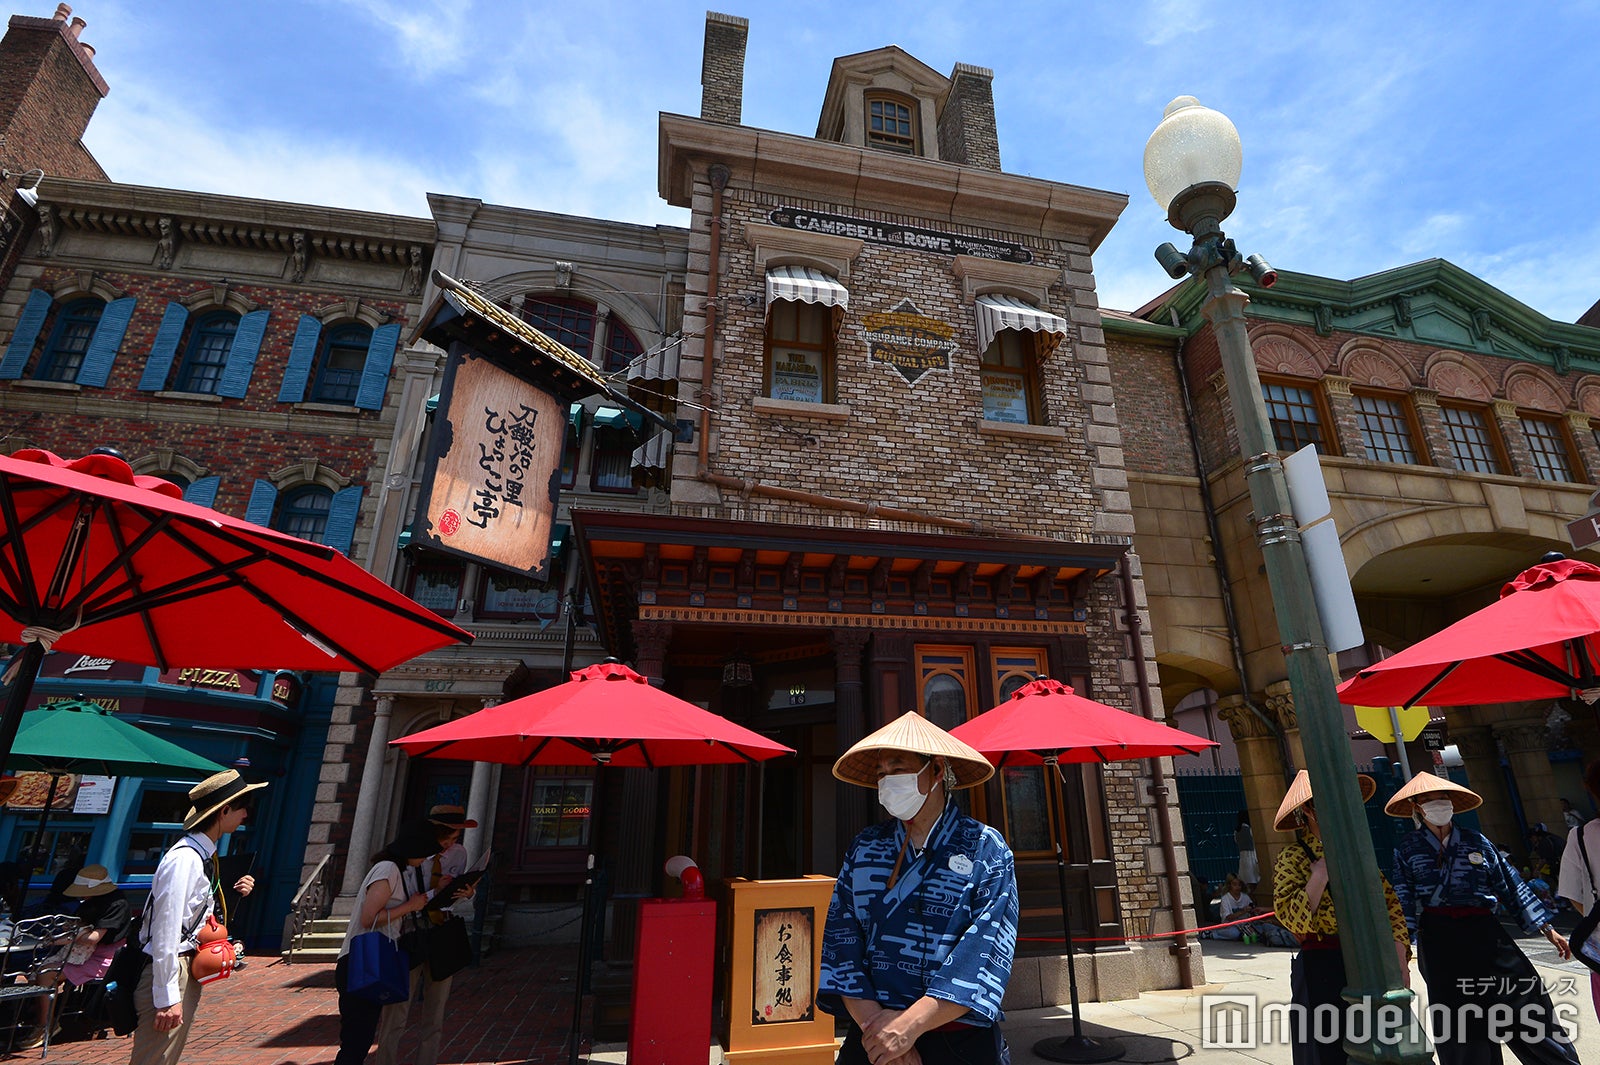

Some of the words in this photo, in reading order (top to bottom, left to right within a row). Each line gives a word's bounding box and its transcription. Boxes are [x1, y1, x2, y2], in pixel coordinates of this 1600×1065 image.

[795, 214, 887, 241] CAMPBELL
[904, 231, 952, 251] ROWE
[859, 330, 912, 346] INSURANCE
[914, 337, 955, 350] COMPANY
[873, 348, 919, 368] MUTUAL
[920, 355, 945, 368] LIFE
[501, 403, 538, 507] 刀鍛冶の里
[466, 406, 508, 529] ひょっとこ亭
[178, 667, 241, 688] PIZZA
[424, 679, 456, 692] 807
[562, 806, 590, 814] GOODS
[774, 923, 793, 1008] お食事処
